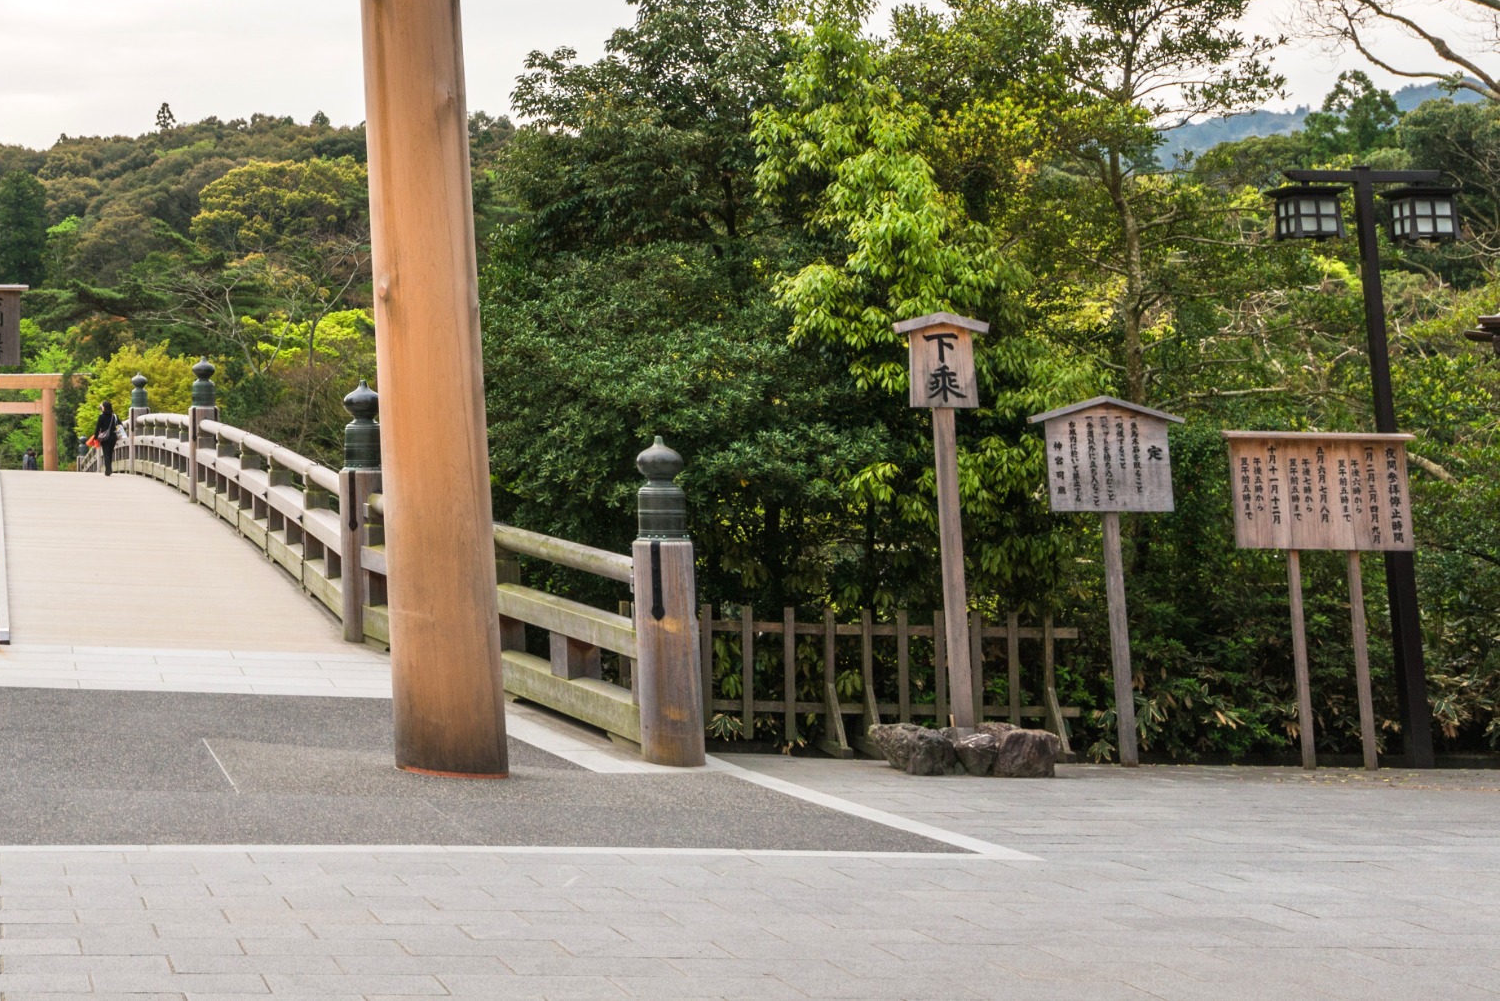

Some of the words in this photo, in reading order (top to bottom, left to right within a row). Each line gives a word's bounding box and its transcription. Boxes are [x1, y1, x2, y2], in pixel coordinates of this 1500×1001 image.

[1147, 445, 1162, 461] 定
[1240, 456, 1253, 521] 翌午前五時まで
[1252, 457, 1264, 512] 午後五時から
[1288, 458, 1302, 521] 翌午前五時まで
[1301, 458, 1313, 513] 午後七時から
[1337, 459, 1351, 523] 翌午前五時まで
[1350, 459, 1362, 514] 午後六時から
[1385, 447, 1404, 544] 夜間参拝停止時間
